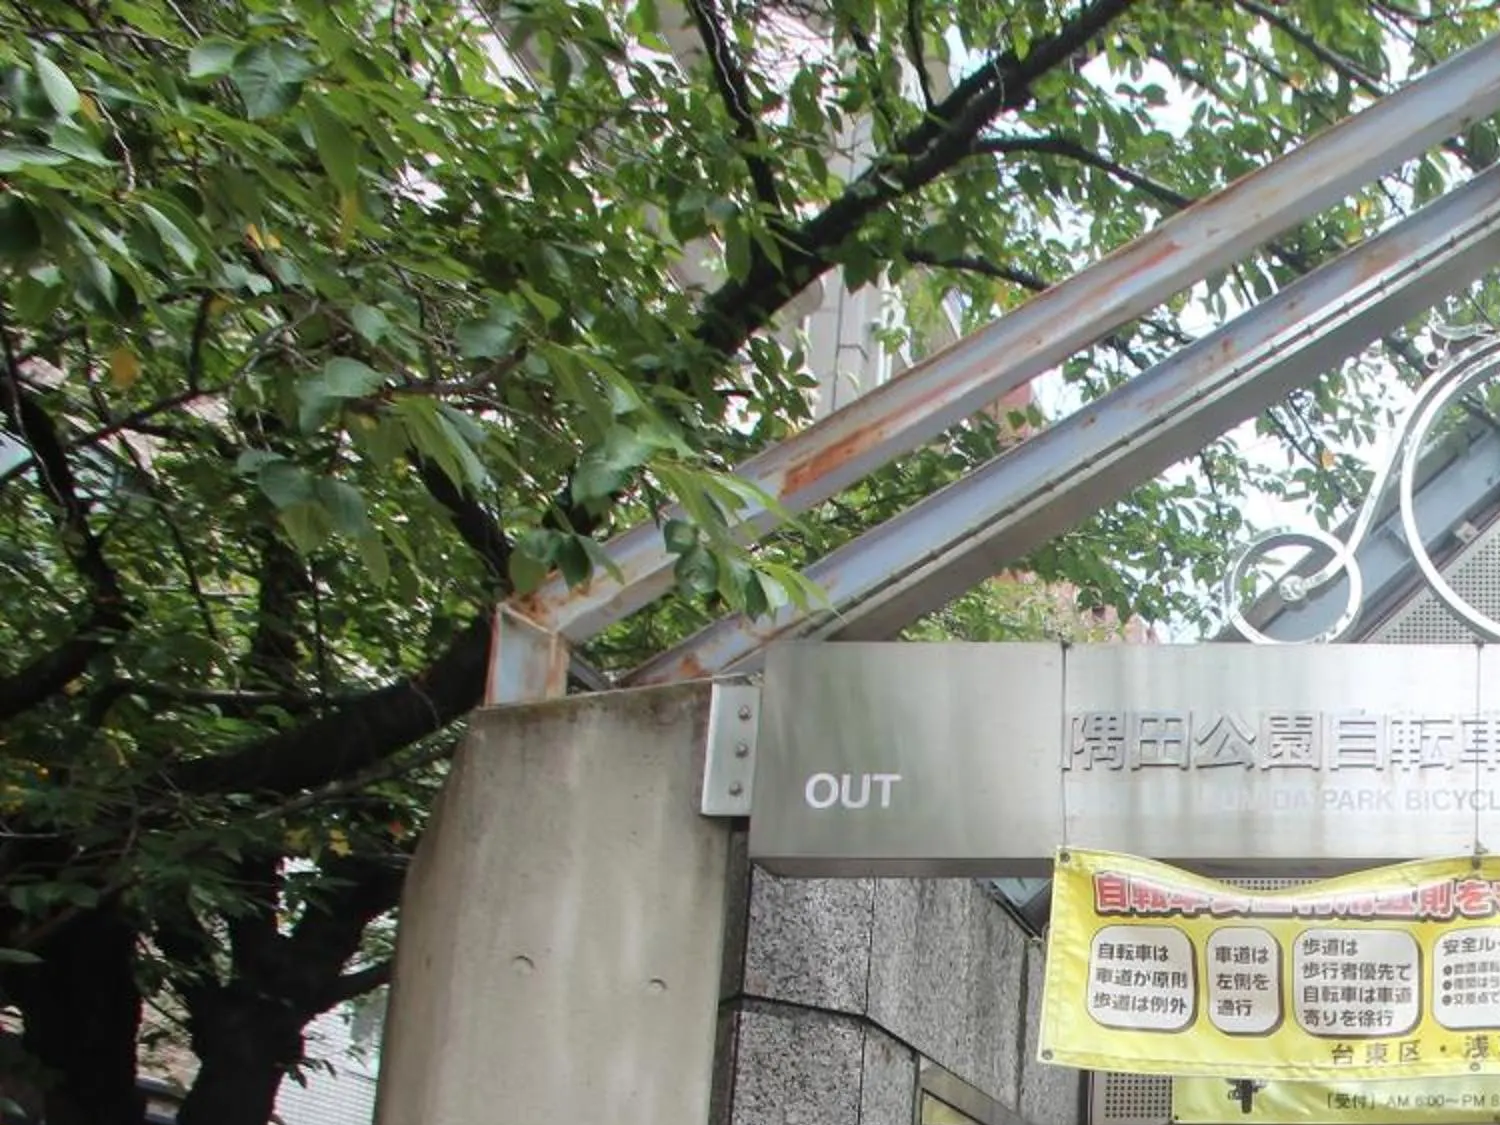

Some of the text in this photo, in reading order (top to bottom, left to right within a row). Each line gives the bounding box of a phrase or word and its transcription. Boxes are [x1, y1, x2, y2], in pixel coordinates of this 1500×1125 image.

[804, 771, 902, 808] OUT
[1321, 788, 1393, 812] PARK
[1097, 942, 1169, 962] 自転車は
[1215, 945, 1270, 965] 車道は
[1302, 938, 1359, 958] 歩道は
[1095, 968, 1188, 989] 車道が原則
[1216, 973, 1271, 993] 左側を
[1092, 994, 1187, 1016] 歩道は例外
[1302, 986, 1412, 1005] 自転車は車道
[1302, 1009, 1394, 1028] 寄りを徐行
